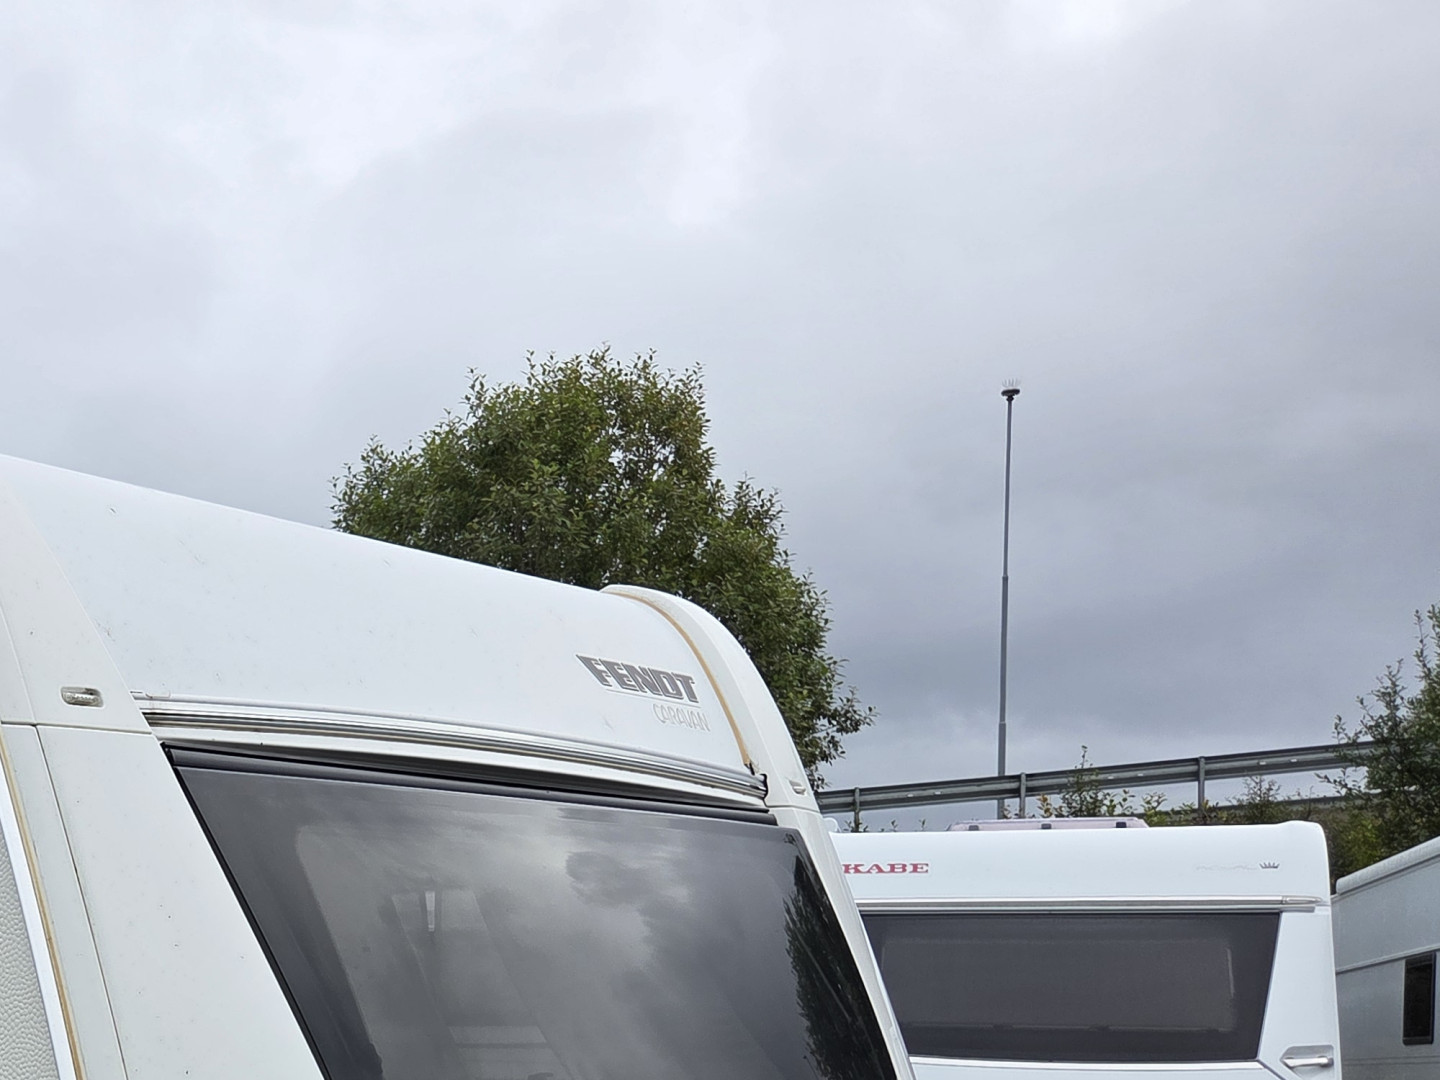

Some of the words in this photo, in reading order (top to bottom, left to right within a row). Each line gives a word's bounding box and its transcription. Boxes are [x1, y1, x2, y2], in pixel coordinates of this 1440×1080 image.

[576, 654, 699, 703] FENDT
[652, 703, 711, 732] CARAVAN
[842, 862, 929, 875] KABE
